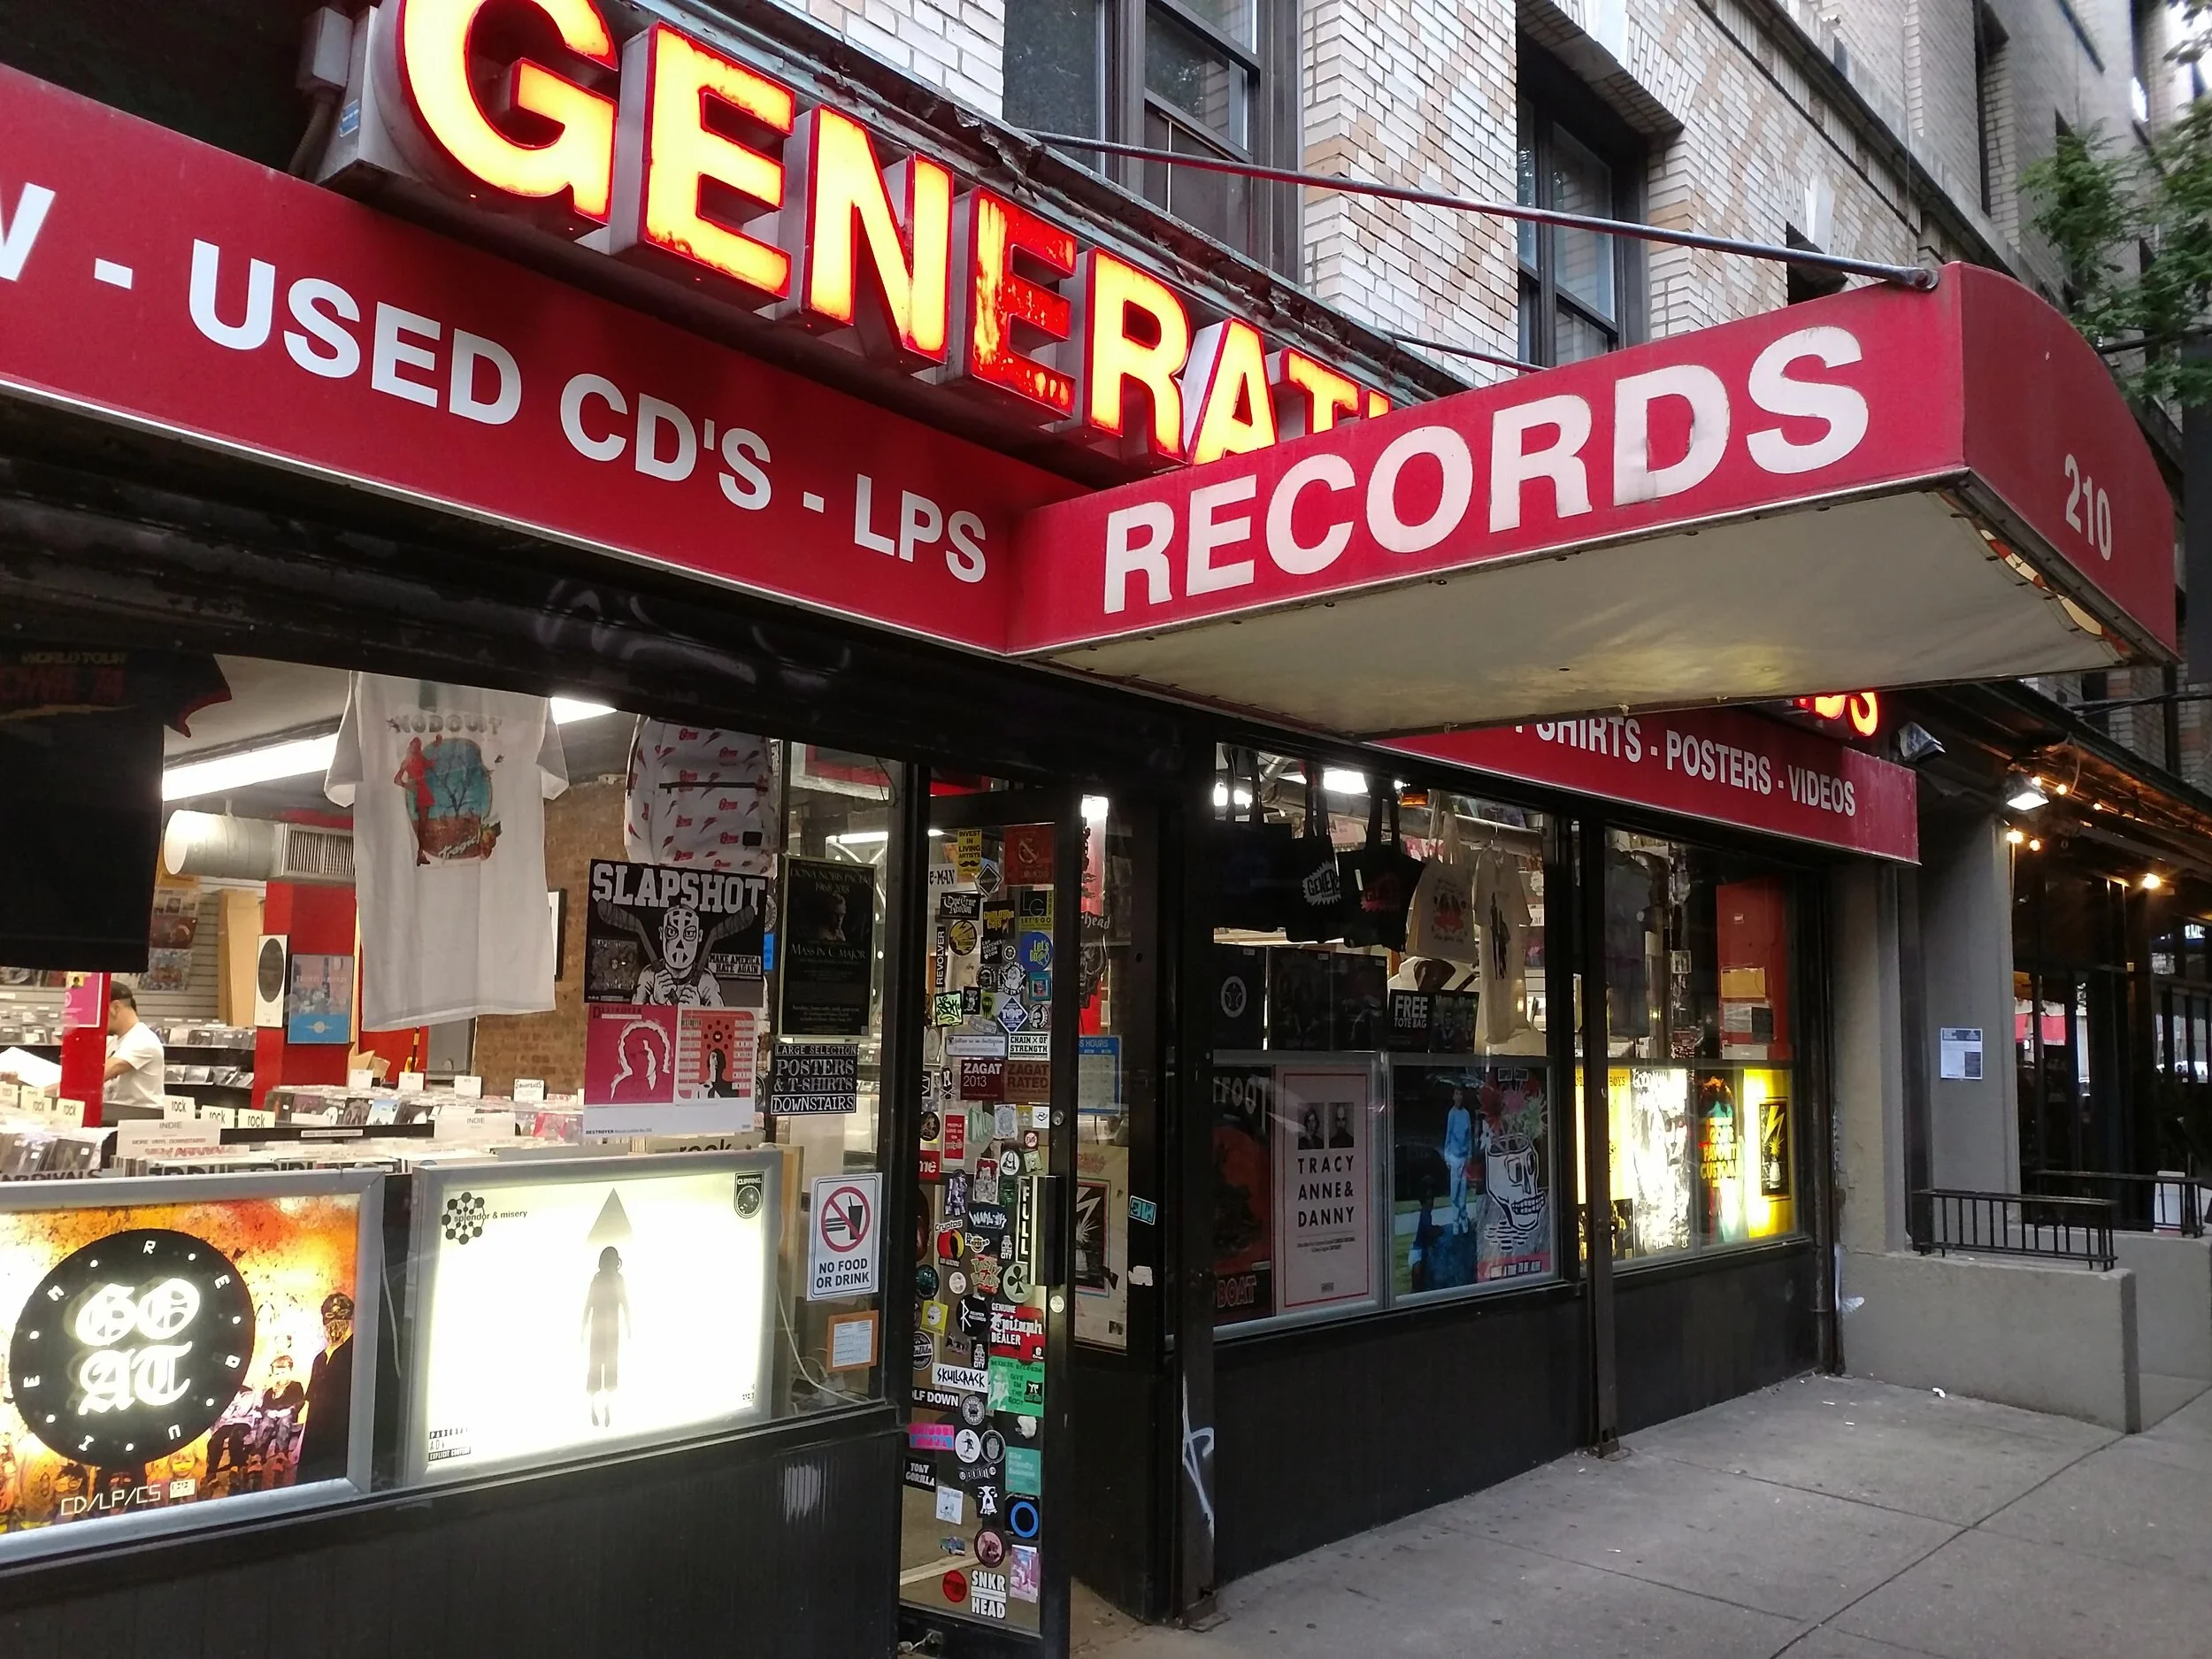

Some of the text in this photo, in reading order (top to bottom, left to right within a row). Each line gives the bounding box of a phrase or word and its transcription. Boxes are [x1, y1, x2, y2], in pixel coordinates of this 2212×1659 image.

[398, 0, 1392, 465] GENERAT
[188, 239, 522, 426] USED
[560, 373, 772, 511] CD'S
[853, 473, 987, 584] LPS
[1104, 326, 1870, 615] RECORDS
[2064, 453, 2113, 562] 210
[1666, 729, 1771, 795] POSTERS
[1787, 764, 1856, 817] VIDEOS
[592, 863, 766, 917] SLAPSHOT
[709, 954, 760, 965] MAKE AMERICA
[936, 931, 945, 985] REVOLVER
[716, 964, 758, 974] HATE AGAIN
[1002, 1009, 1023, 1019] TOP
[1394, 995, 1428, 1019] FREE
[1394, 1018, 1427, 1029] TOTE BAG
[775, 1046, 856, 1056] LARGE SELECTION
[776, 1059, 855, 1077] POSTERS
[964, 1063, 1002, 1075] ZAGAT
[1008, 1064, 1049, 1075] ZAGAT
[773, 1078, 854, 1093] & T-SHIRTS
[963, 1075, 987, 1087] 2013
[1007, 1076, 1048, 1088] RATED
[172, 1101, 187, 1113] rock
[772, 1095, 855, 1113] DOWNSTAIRS
[248, 1114, 265, 1128] rock
[1297, 1155, 1355, 1174] TRACY
[454, 1209, 528, 1224] splendor & misery
[1297, 1207, 1355, 1228] DANNY
[818, 1258, 868, 1274] NO FOOD
[816, 1271, 870, 1288] OR DRINK
[1217, 1275, 1256, 1309] BOAT
[991, 1302, 1017, 1313] GENUINE
[991, 1333, 1021, 1345] DEALER
[937, 1368, 985, 1387] SKULLCRACK
[912, 1388, 959, 1407] LF DOWN
[910, 1463, 930, 1473] TONY
[905, 1472, 935, 1486] GORILLA
[61, 1484, 161, 1517] CD/LP/CS
[972, 1570, 1005, 1592] SNKR
[972, 1597, 1005, 1619] HEAD
